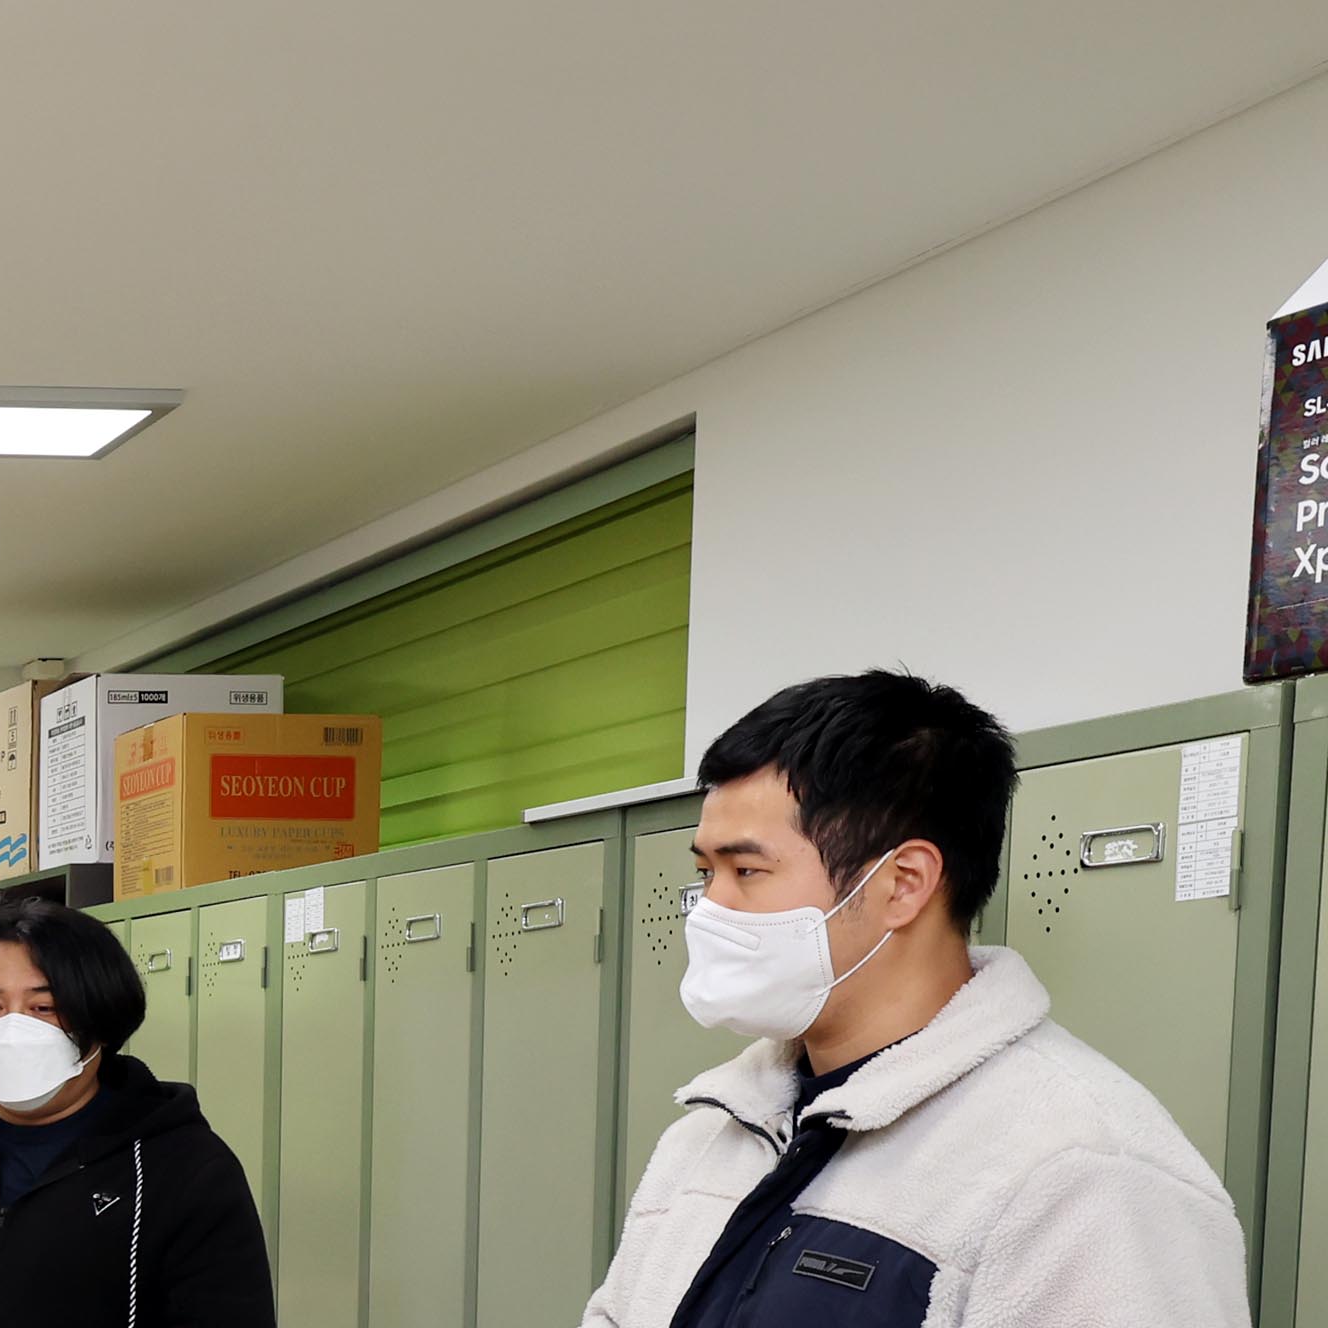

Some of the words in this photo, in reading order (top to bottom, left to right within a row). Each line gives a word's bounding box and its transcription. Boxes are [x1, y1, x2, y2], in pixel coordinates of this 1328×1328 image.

[1291, 336, 1328, 366] SA
[233, 692, 265, 703] 위생용품
[220, 775, 305, 797] SEOYEON
[310, 776, 346, 798] CUP
